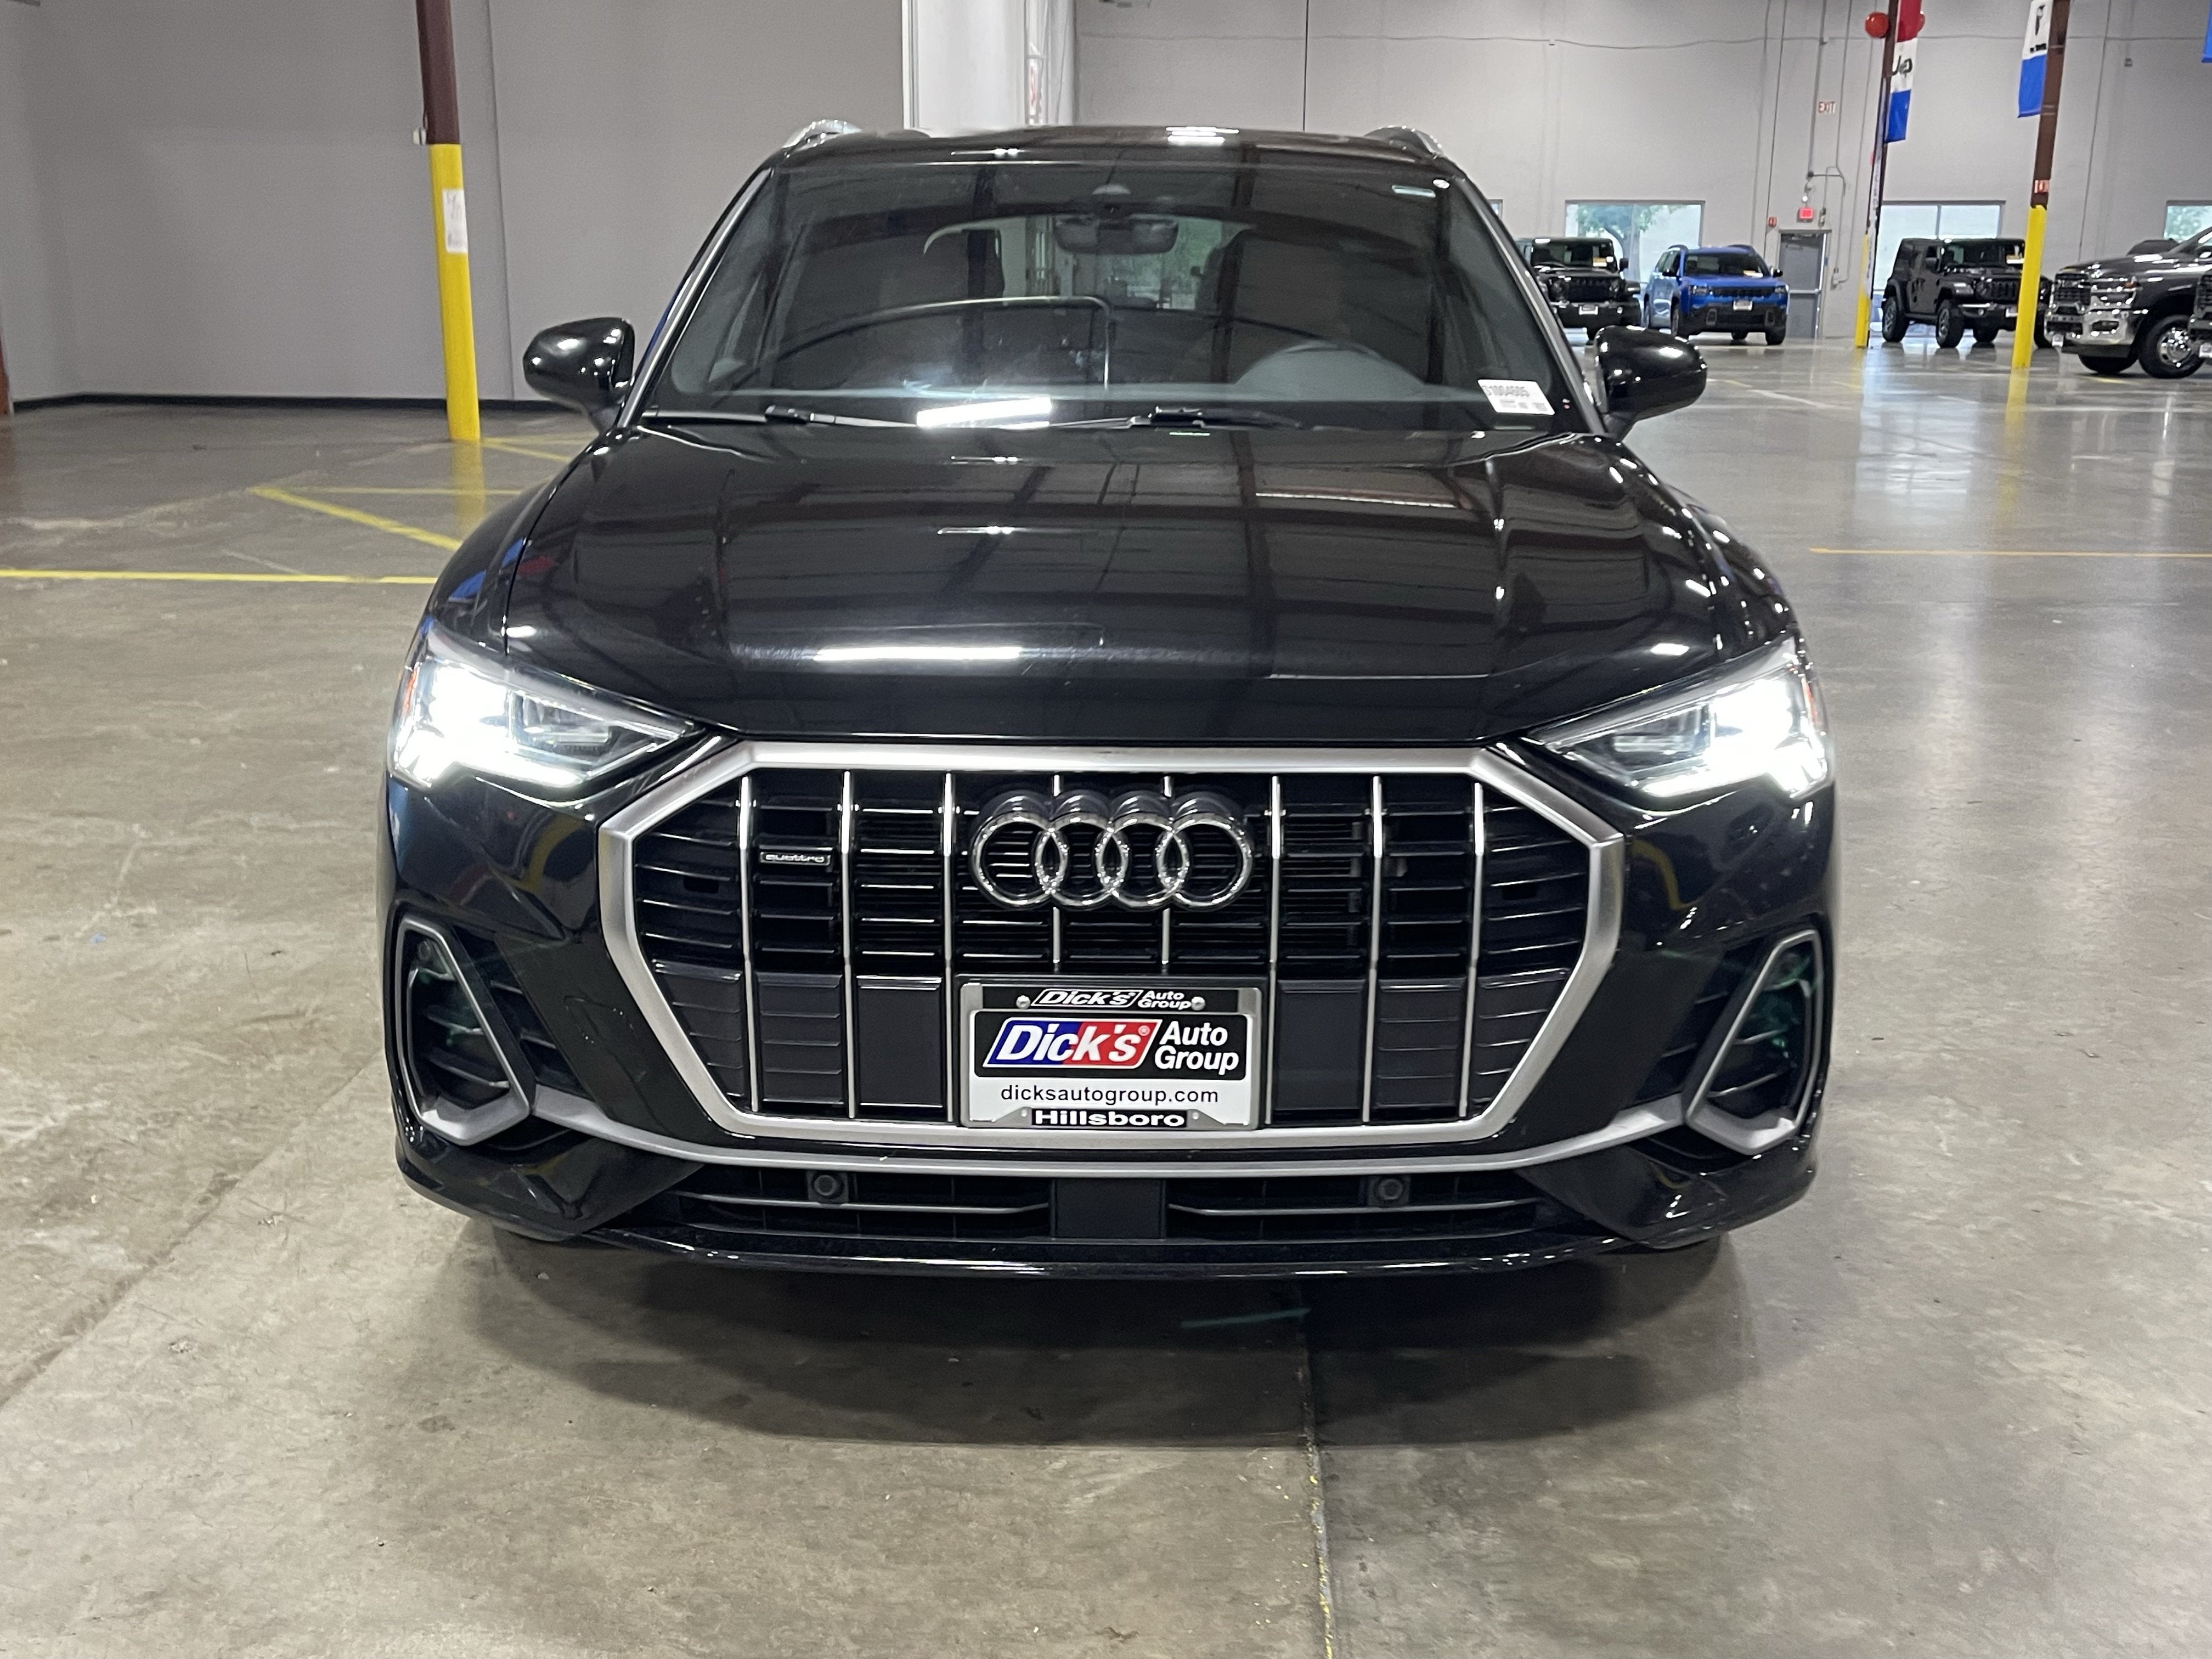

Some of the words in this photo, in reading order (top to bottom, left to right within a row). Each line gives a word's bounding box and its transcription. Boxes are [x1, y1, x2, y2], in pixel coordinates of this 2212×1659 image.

[765, 854, 825, 863] quattro
[1039, 990, 1130, 1005] Dick's
[1137, 998, 1192, 1010] Group
[1142, 990, 1185, 1001] Auto
[1159, 1020, 1228, 1046] Auto
[996, 1023, 1141, 1063] Dick's
[1154, 1045, 1239, 1075] Group
[1001, 1084, 1218, 1106] dicksautogroup.com
[1035, 1110, 1185, 1127] Hillsboro
